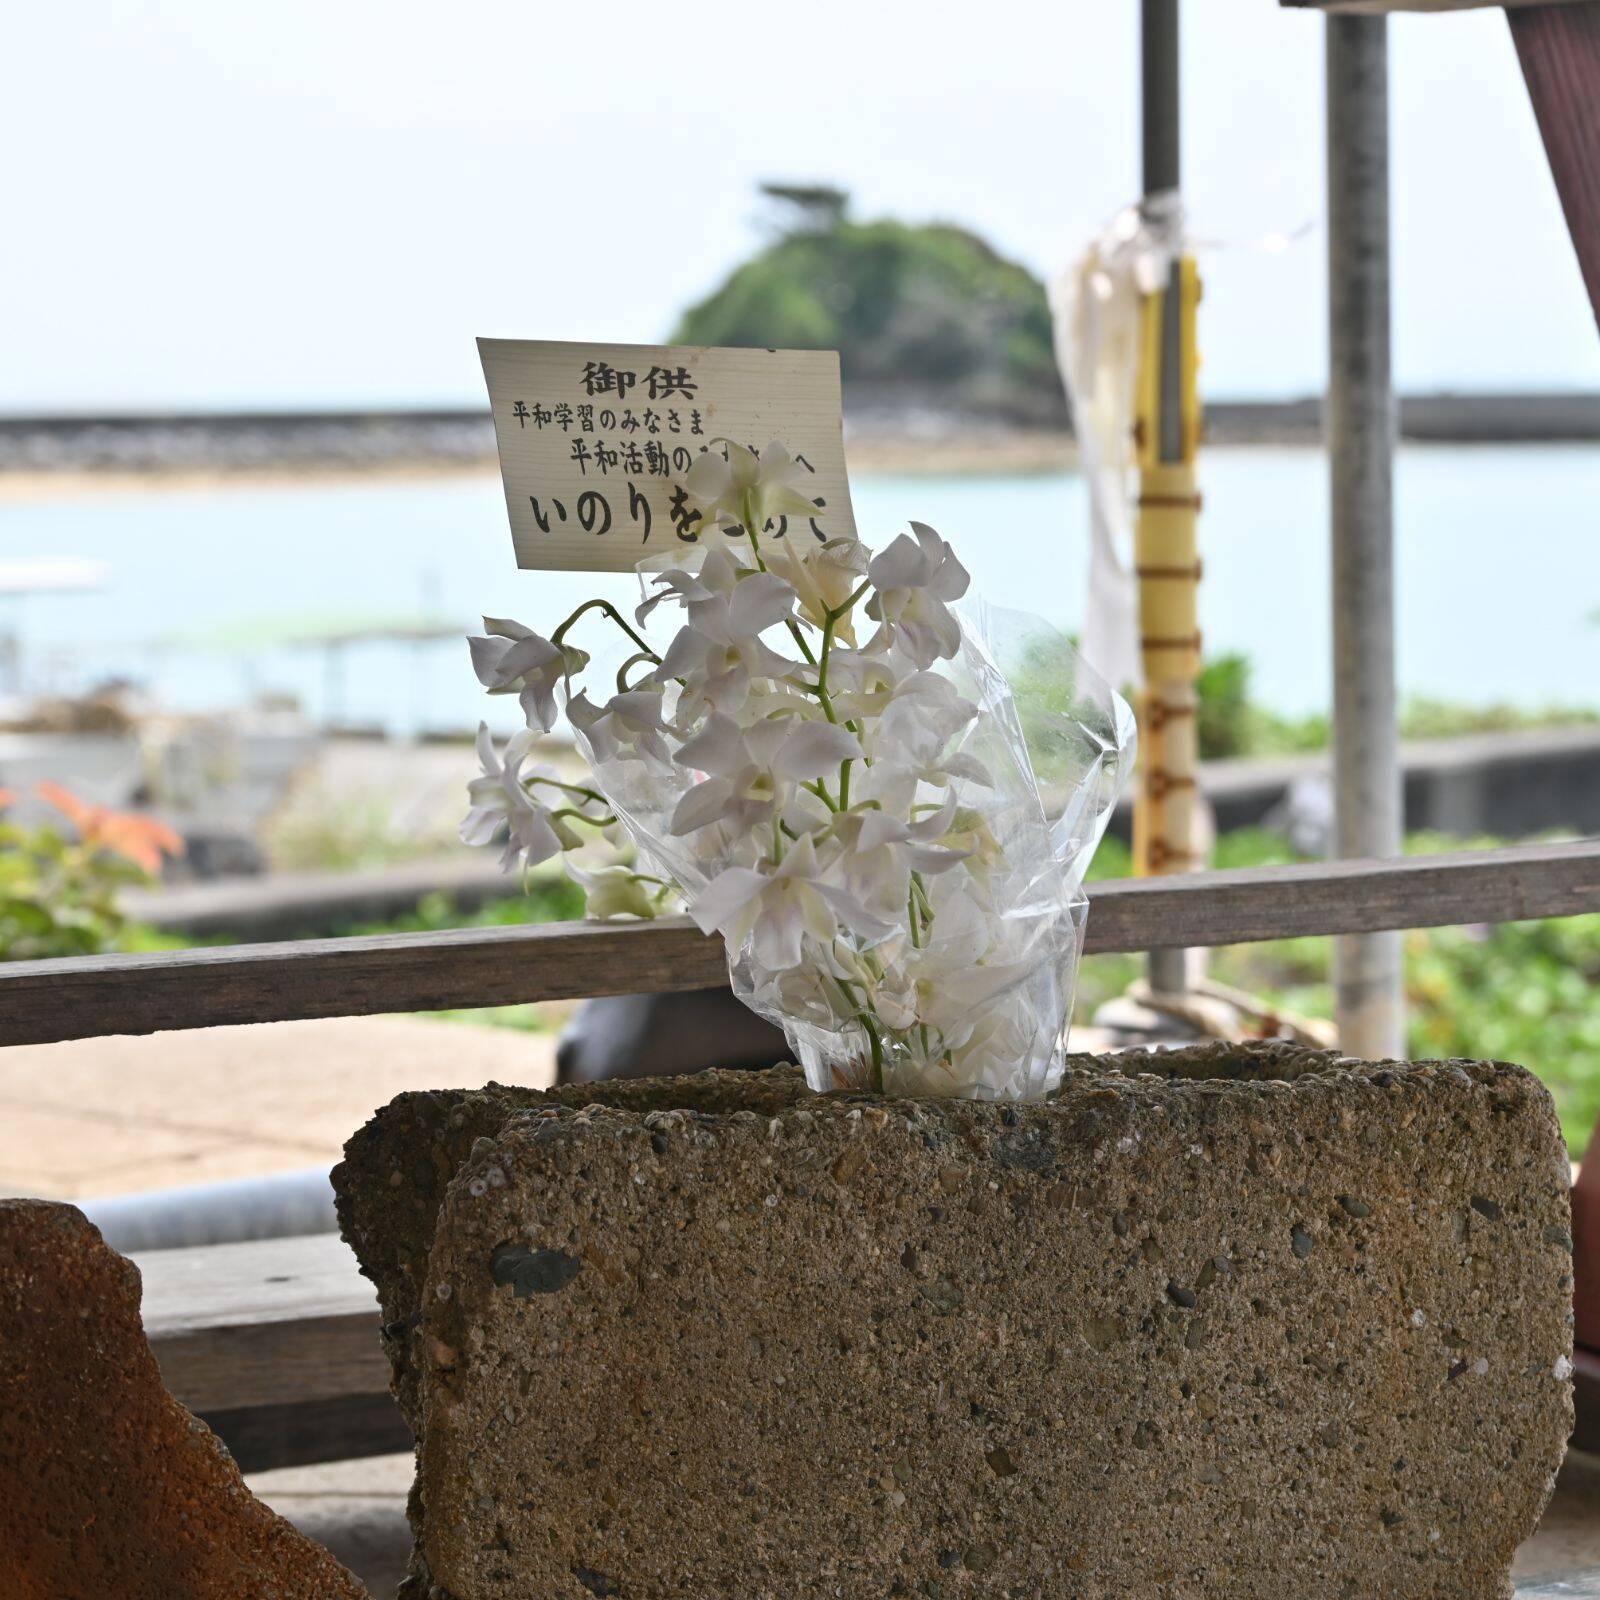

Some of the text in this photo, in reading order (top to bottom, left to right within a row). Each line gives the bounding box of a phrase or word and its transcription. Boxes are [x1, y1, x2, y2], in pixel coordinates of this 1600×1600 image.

[579, 361, 698, 400] 御供
[512, 400, 705, 436] 平和学習のみなさま
[570, 437, 816, 478] 平和活動のへ
